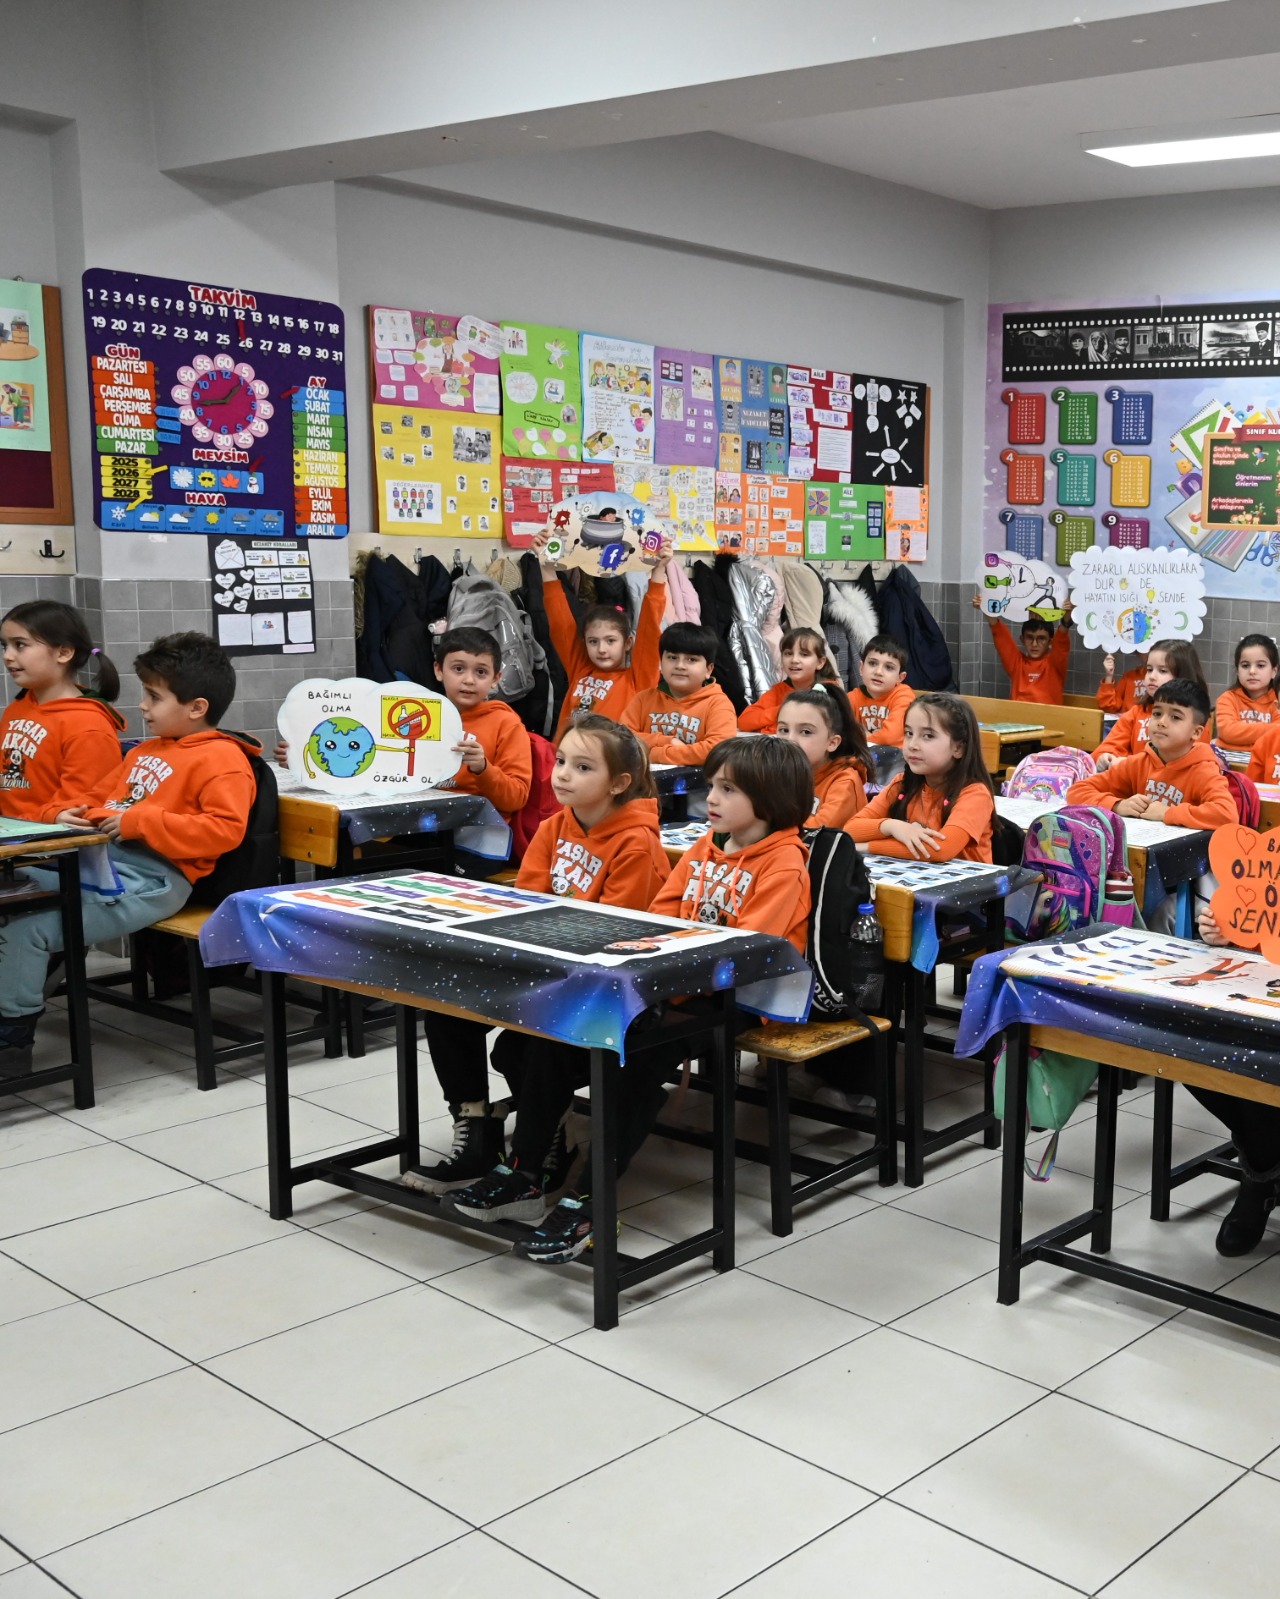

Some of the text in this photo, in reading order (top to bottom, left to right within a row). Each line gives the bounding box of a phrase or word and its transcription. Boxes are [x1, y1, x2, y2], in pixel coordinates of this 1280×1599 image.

[188, 285, 256, 310] TAKVİM
[87, 288, 340, 335] 1 2 3 4 5 6 7 8 9 10 11 12 13 14 15 16 17 18
[91, 316, 343, 362] 19 20 21 22 23 24 25 26 27 28 29 30 31
[105, 343, 140, 360] GÜN
[113, 373, 134, 386] SALI
[308, 376, 327, 388] AY
[100, 385, 151, 401] ÇARŞAMBA
[306, 389, 330, 401] OCAK
[1008, 392, 1014, 401] 1
[1057, 391, 1065, 400] 2
[1111, 391, 1119, 400] 3
[104, 399, 152, 415] PERŞEMBE
[305, 401, 330, 413] ŞUBAT
[306, 413, 330, 425] MART
[307, 425, 332, 438] NİSAN
[115, 441, 147, 454] PAZAR
[306, 439, 330, 450] MAYIS
[111, 456, 139, 467] 2025
[193, 448, 249, 463] MEVSİM
[304, 451, 338, 463] HAZİRAN
[1006, 453, 1014, 462] 4
[1056, 453, 1064, 462] 5
[1110, 453, 1117, 463] 6
[112, 467, 140, 478] 2026
[305, 462, 339, 475] TEMMUZ
[112, 478, 139, 488] 2027
[304, 475, 339, 487] AĞUSTOS
[113, 488, 140, 498] 2028
[185, 492, 226, 505] HAVA
[308, 488, 333, 499] EYLÜL
[311, 500, 332, 511] EKİM
[310, 512, 335, 523] KASIM
[1005, 512, 1012, 521] 7
[1055, 514, 1063, 523] 8
[1108, 515, 1116, 525] 9
[306, 525, 335, 536] ARALIK
[1082, 563, 1122, 575] ZARARLI
[1095, 578, 1115, 590] DUR
[1084, 593, 1115, 603] HAYATIN
[307, 689, 352, 700] BAĞIMLI
[322, 704, 352, 713] OLMA
[1, 732, 37, 759] AKAR
[125, 767, 159, 795] AKAR
[373, 772, 433, 784] ÖZGÜR OL
[551, 858, 592, 893] KAR
